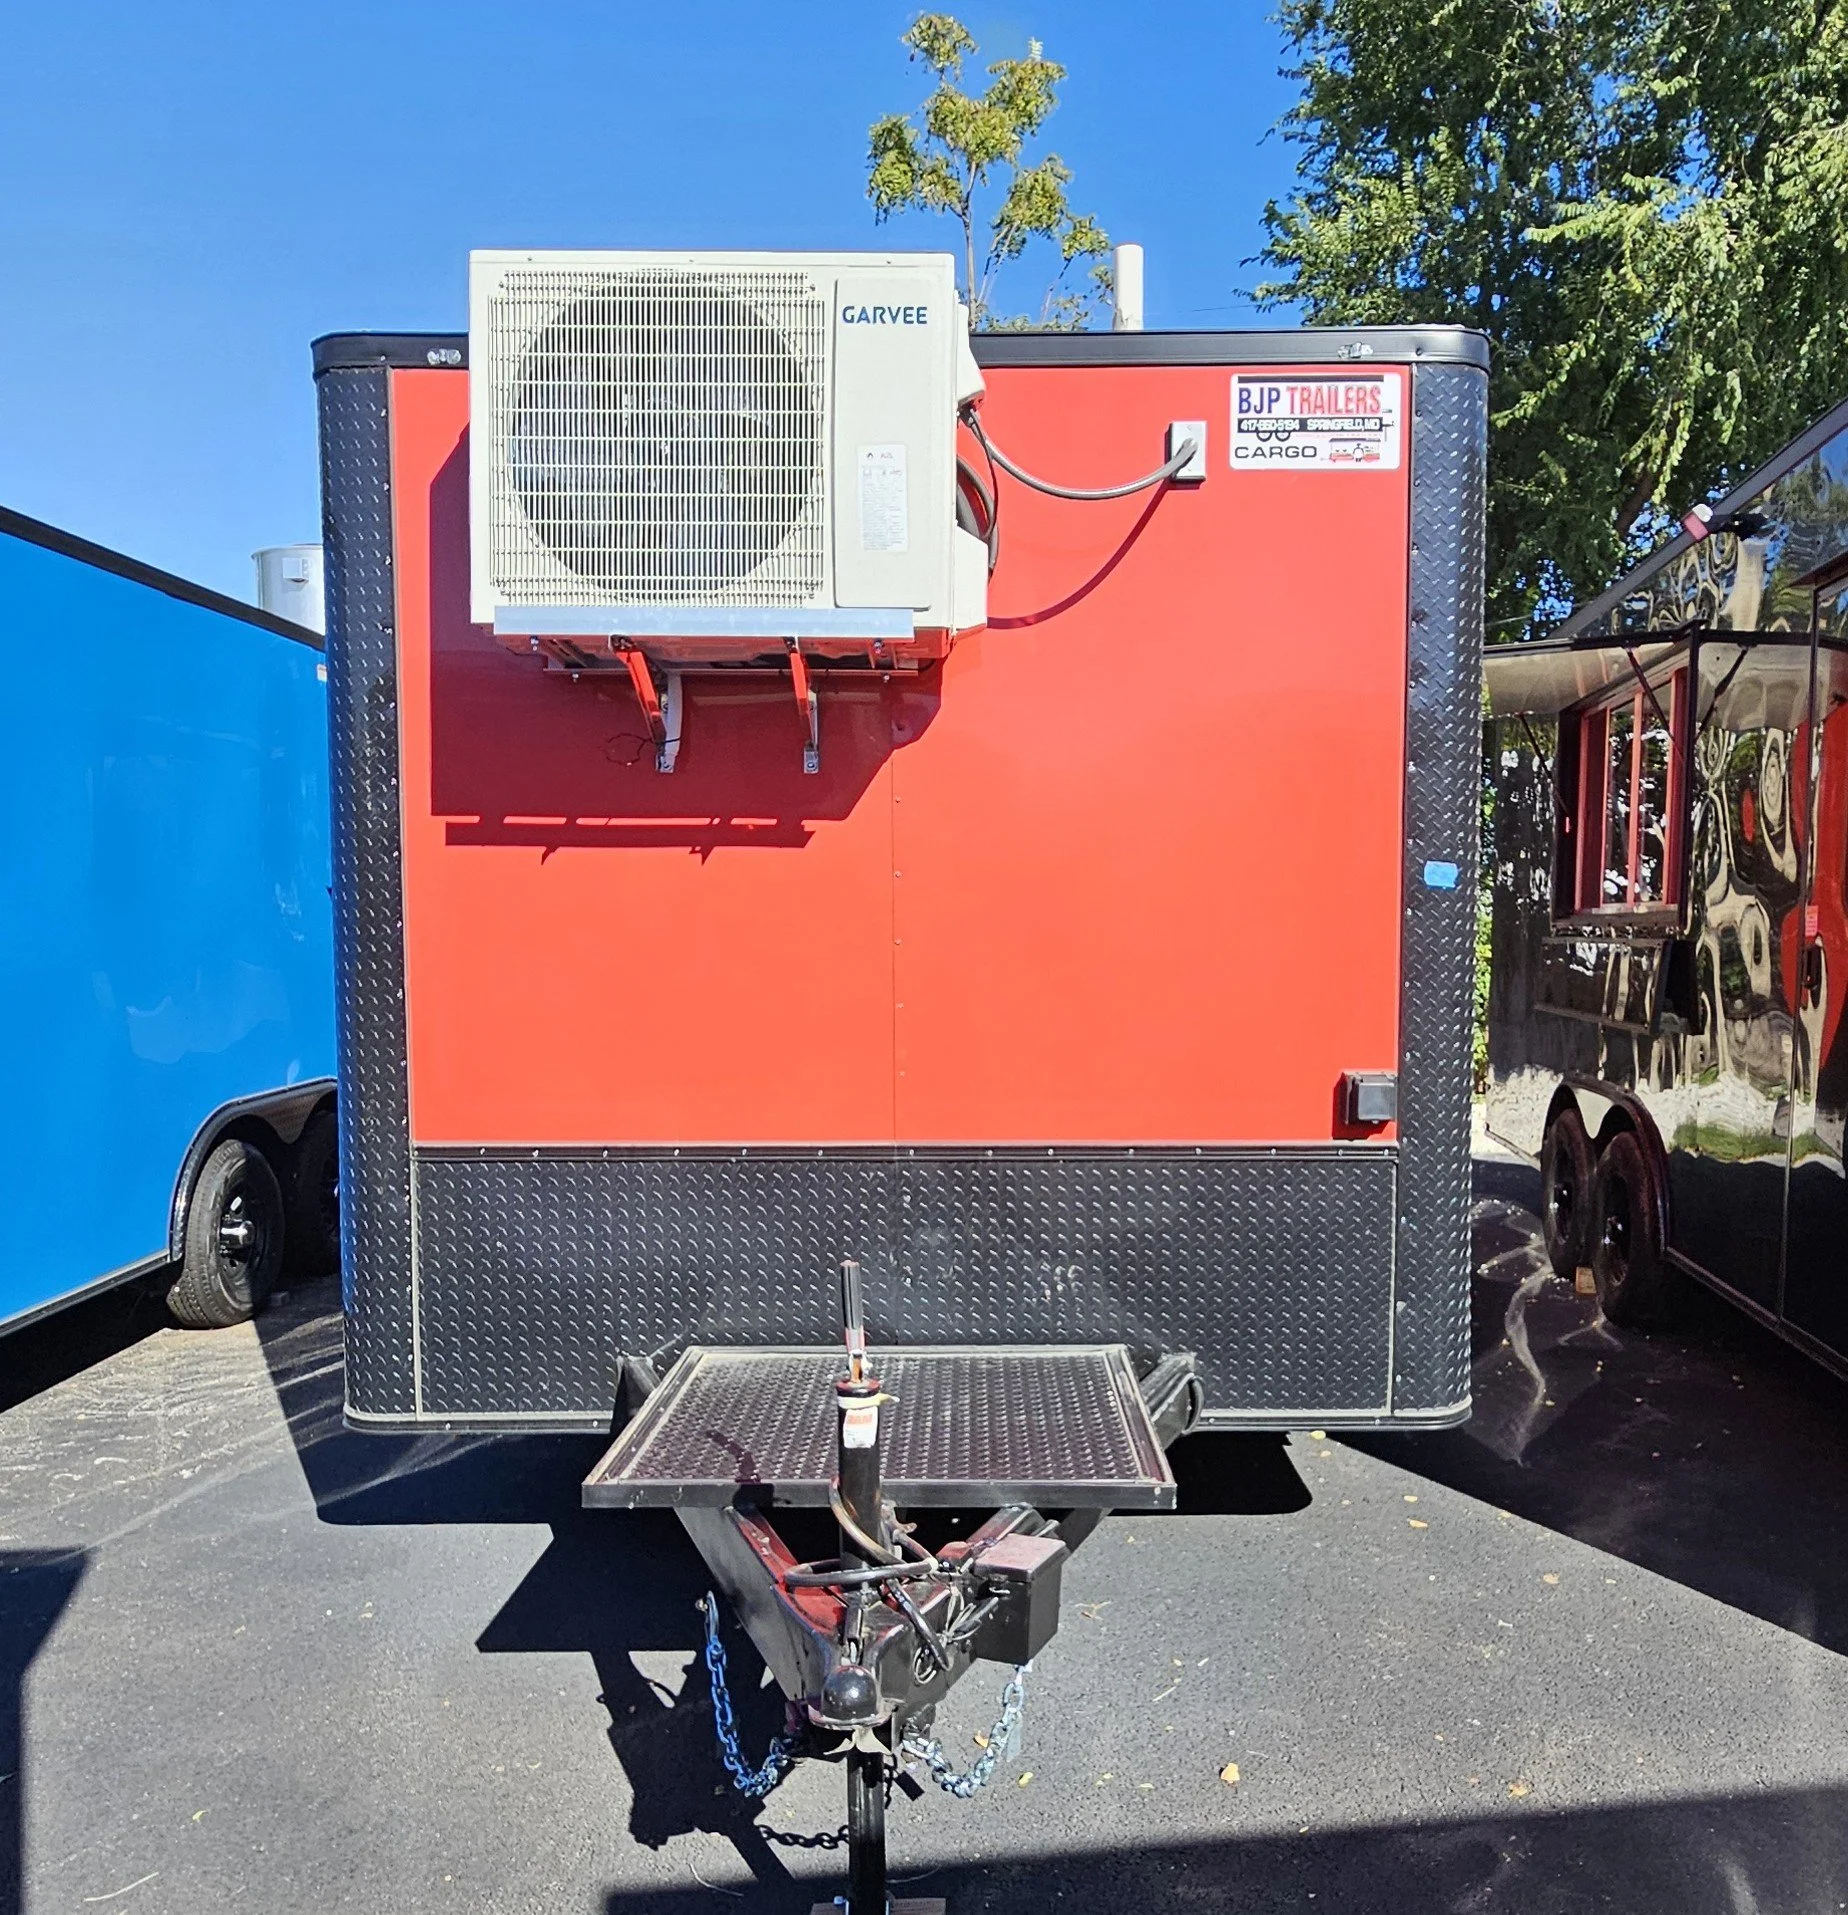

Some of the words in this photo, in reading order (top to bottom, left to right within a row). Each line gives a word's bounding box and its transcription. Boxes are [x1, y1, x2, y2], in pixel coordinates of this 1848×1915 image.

[842, 306, 928, 324] GARVEE
[1238, 387, 1281, 414] BJP
[1286, 385, 1381, 415] TRAILERS
[1234, 446, 1317, 459] CARGO
